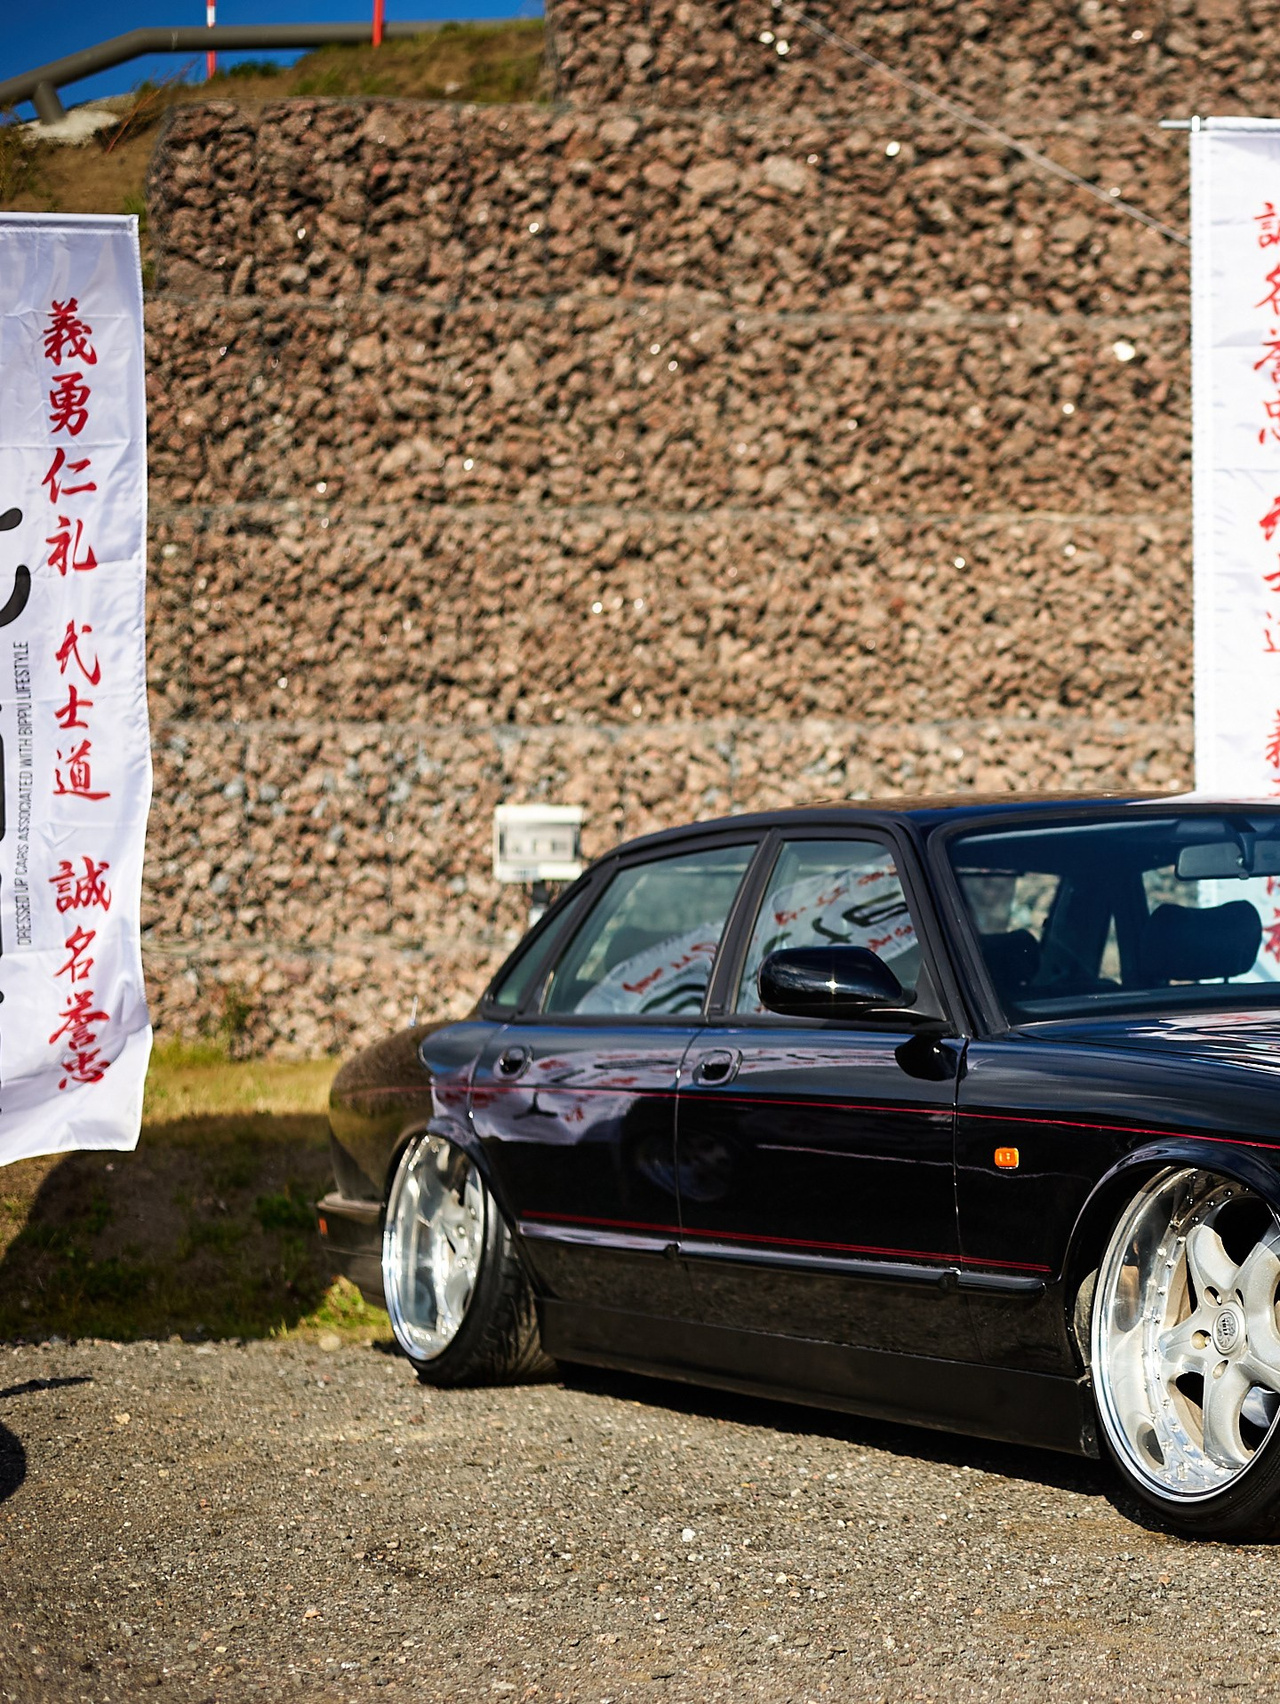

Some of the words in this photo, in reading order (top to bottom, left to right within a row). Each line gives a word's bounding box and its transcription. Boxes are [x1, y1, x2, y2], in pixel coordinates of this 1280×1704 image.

[13, 641, 31, 700] LIFESTYLE
[16, 702, 33, 735] BIPPU
[18, 738, 33, 768] WITH
[17, 771, 33, 842] ASSOCIATED
[15, 844, 29, 876] CARS
[14, 878, 29, 894] UP
[15, 896, 32, 945] DRESSED
